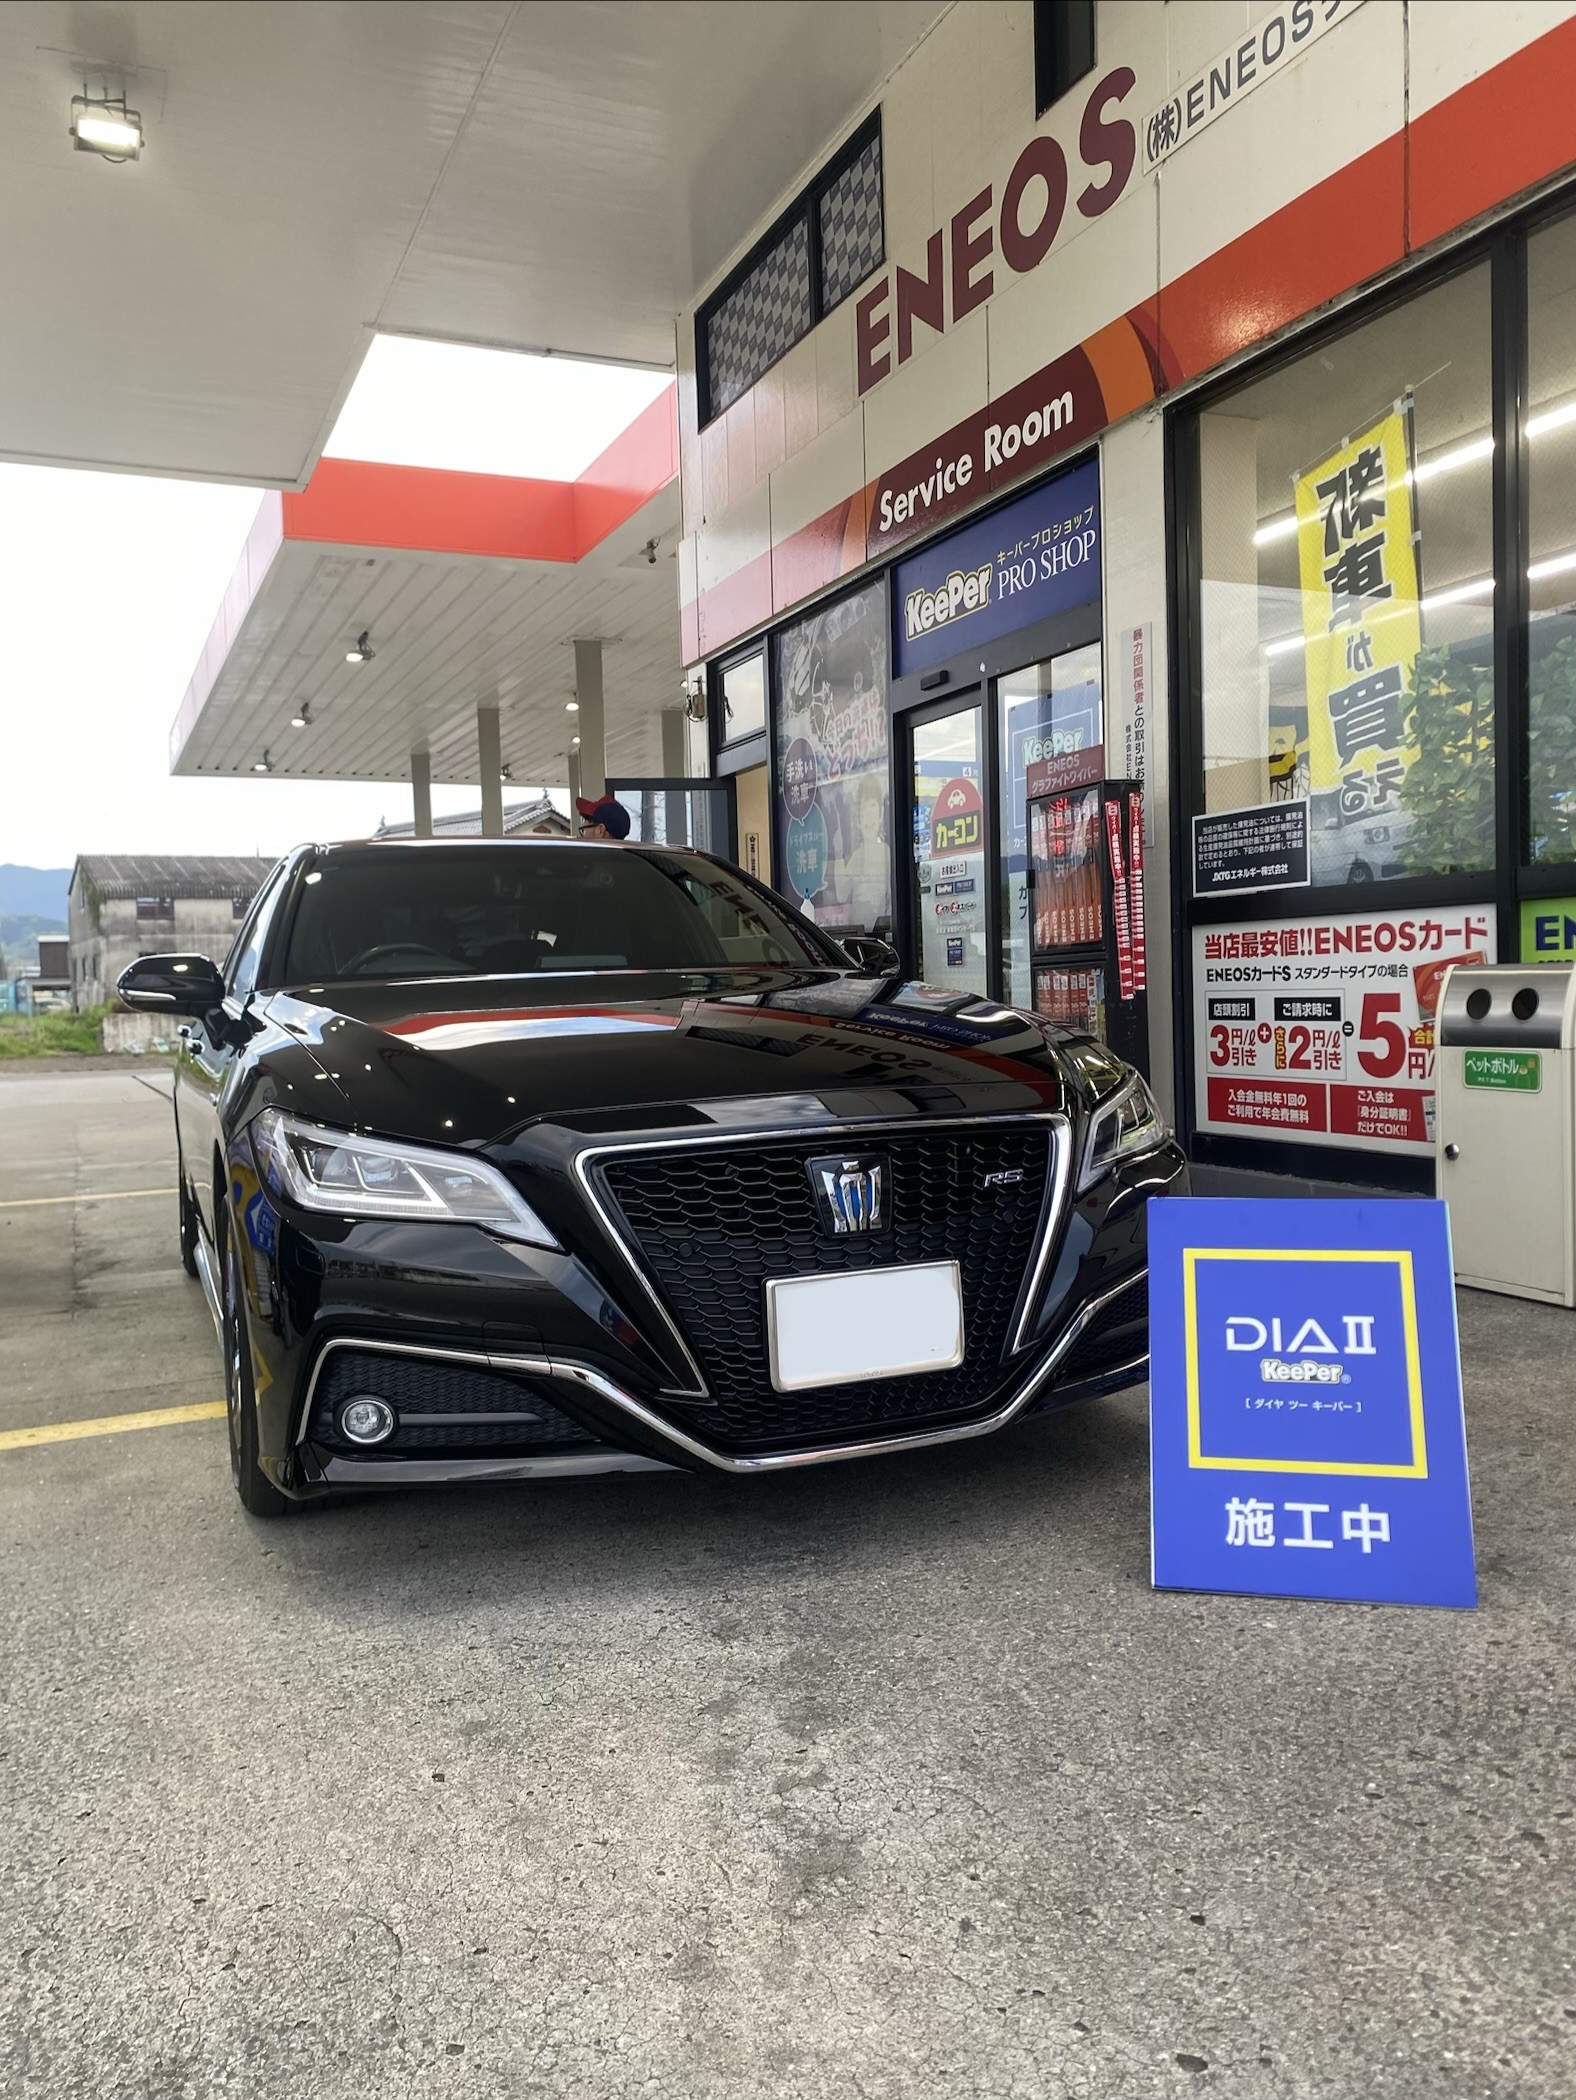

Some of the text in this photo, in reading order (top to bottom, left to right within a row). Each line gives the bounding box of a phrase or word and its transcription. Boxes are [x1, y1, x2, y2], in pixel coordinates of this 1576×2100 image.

[856, 66, 1136, 397] ENEOS
[879, 391, 1074, 533] Service Room
[997, 505, 1095, 565] キーパープロショップ
[997, 529, 1097, 600] PRO SHOP
[905, 563, 993, 641] KeePer
[1022, 729, 1084, 768] KeePer
[1047, 753, 1080, 775] ENEOS
[1031, 768, 1098, 794] グラファイトワイパー
[790, 785, 810, 805] 洗車
[936, 815, 980, 849] カーコン
[796, 848, 818, 873] 洗車
[1205, 917, 1488, 959] 当店最安値!!ENEOSカード
[1206, 964, 1408, 982] ENEOSカードS スタンダードタイプの場合
[1213, 1003, 1250, 1017] 店頭割引
[1282, 1003, 1333, 1017] ご請求時に
[1210, 1024, 1230, 1067] 3
[1275, 1026, 1287, 1070] さらに
[1288, 1025, 1312, 1070] 2
[1357, 993, 1406, 1079] 5
[1231, 1047, 1257, 1066] 引き
[1313, 1049, 1342, 1070] 引き
[1466, 1057, 1519, 1074] ペットボトル
[1228, 1089, 1307, 1107] 入会金無料年1回の
[1357, 1090, 1395, 1104] ご入会は
[1228, 1105, 1309, 1124] ご利用で年会費無料
[1357, 1121, 1408, 1136] だけでOK!!
[983, 1169, 1024, 1188] RS
[1254, 1398, 1355, 1412] ダイヤ ツー キーパー
[1224, 1497, 1391, 1554] 施工中
